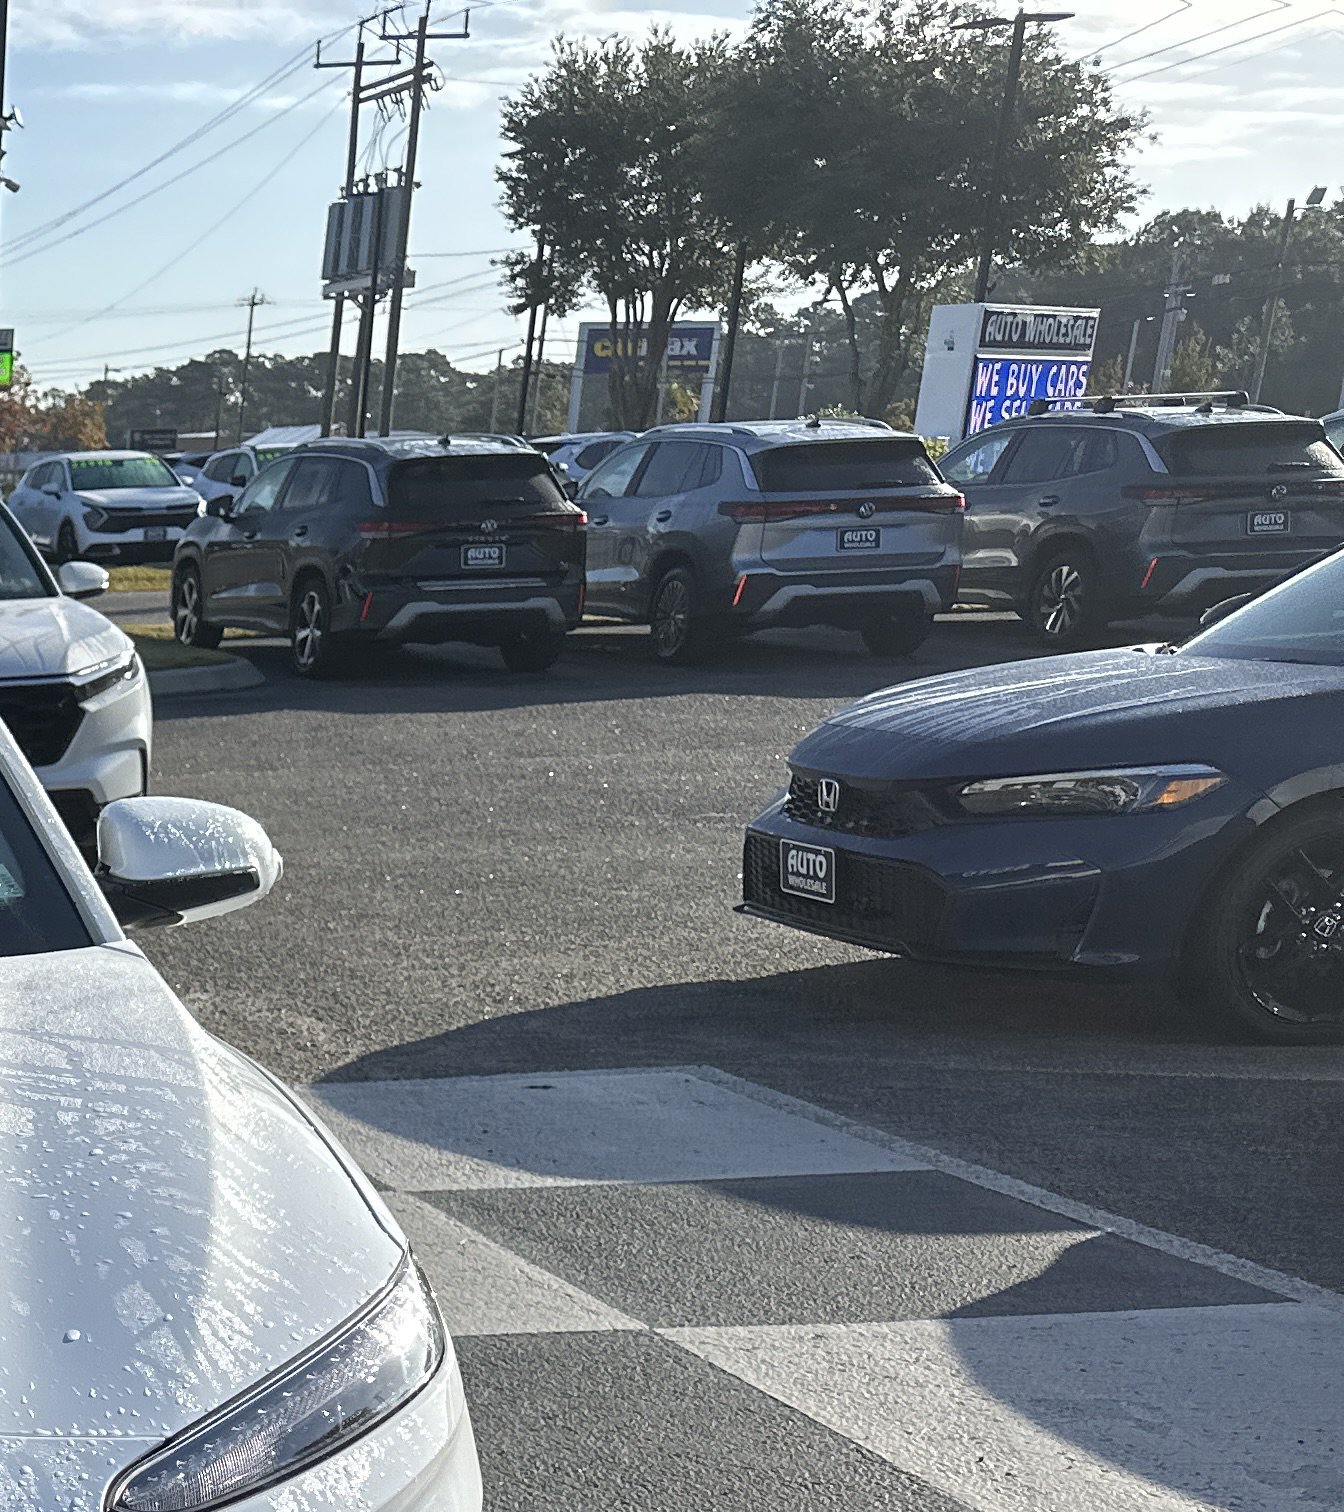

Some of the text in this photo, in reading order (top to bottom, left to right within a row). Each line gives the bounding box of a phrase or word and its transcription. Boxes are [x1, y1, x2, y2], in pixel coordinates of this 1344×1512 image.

[986, 314, 1094, 345] AUTO WHOLESALE
[975, 362, 1088, 398] WE BUY CARS
[969, 399, 994, 434] WE
[1254, 514, 1285, 525] AUTO
[844, 530, 876, 542] AUTO
[468, 548, 499, 559] AUTO
[788, 850, 827, 878] AUTO
